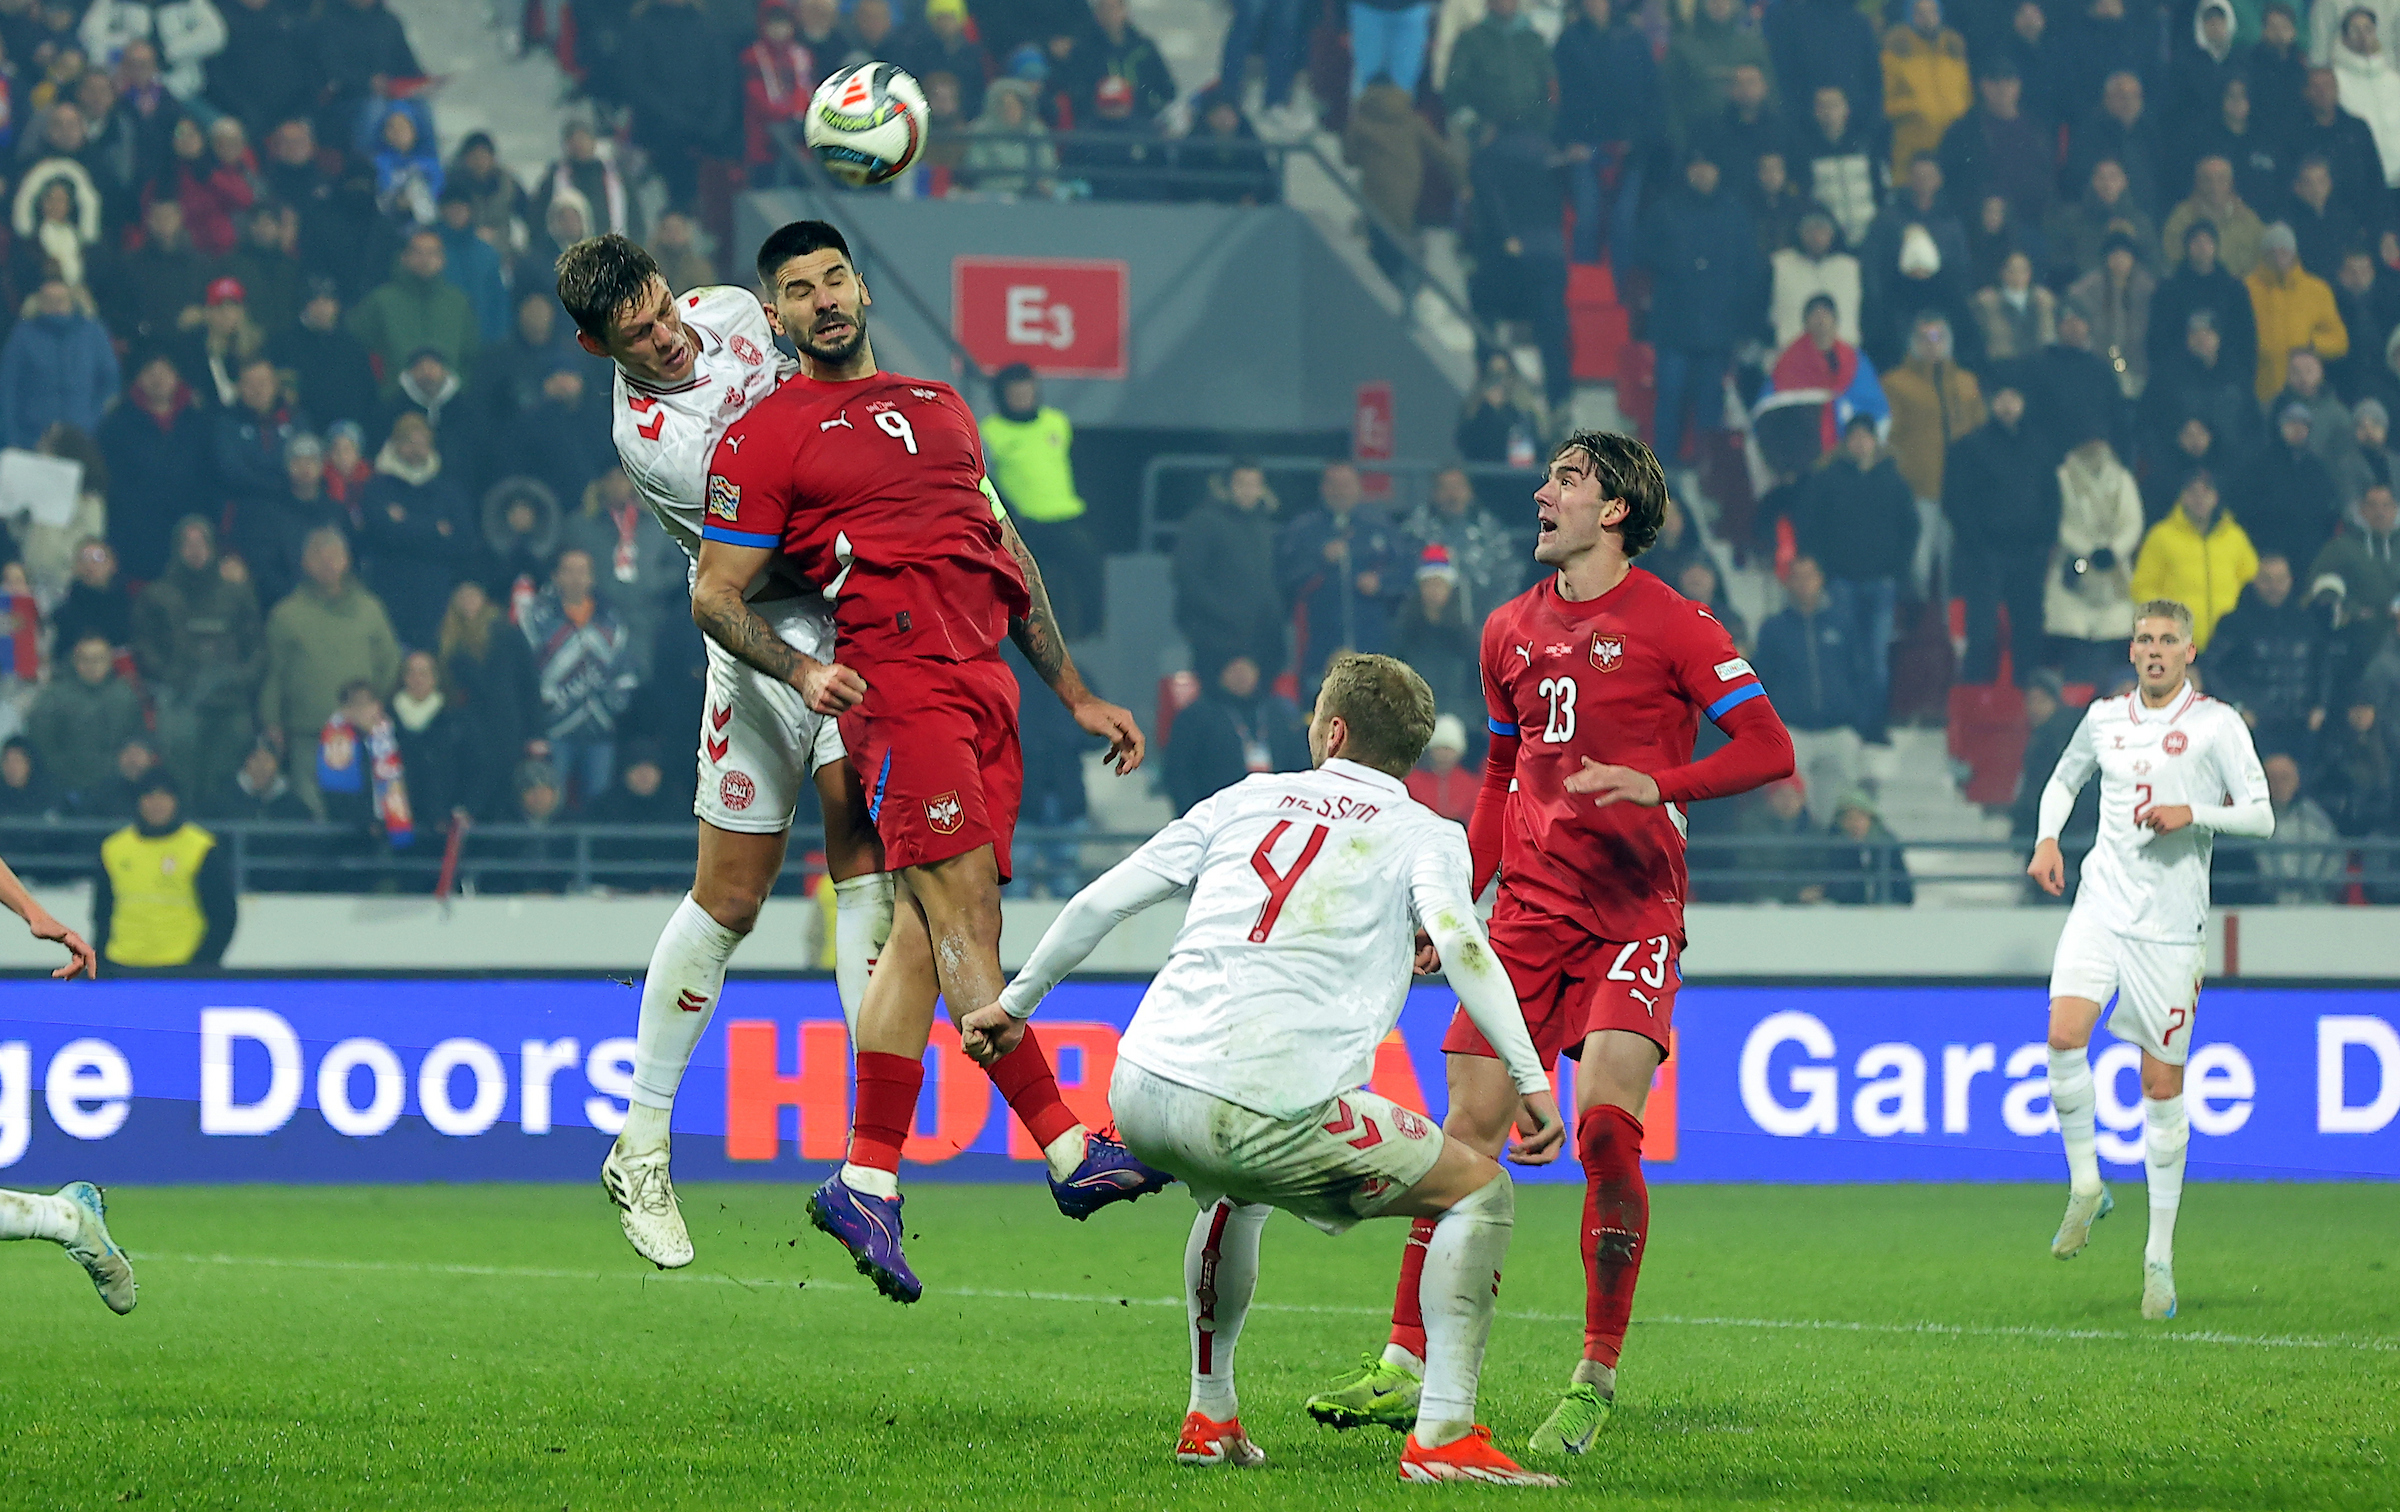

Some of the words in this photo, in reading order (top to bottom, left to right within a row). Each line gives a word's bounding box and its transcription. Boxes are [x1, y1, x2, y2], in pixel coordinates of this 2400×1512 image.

[1006, 285, 1076, 350] E3
[874, 410, 919, 455] 9
[1538, 676, 1577, 743] 23
[1248, 819, 1331, 943] 4
[1606, 934, 1669, 989] 23
[200, 1006, 638, 1138] Doors
[1739, 1009, 2257, 1166] Garage
